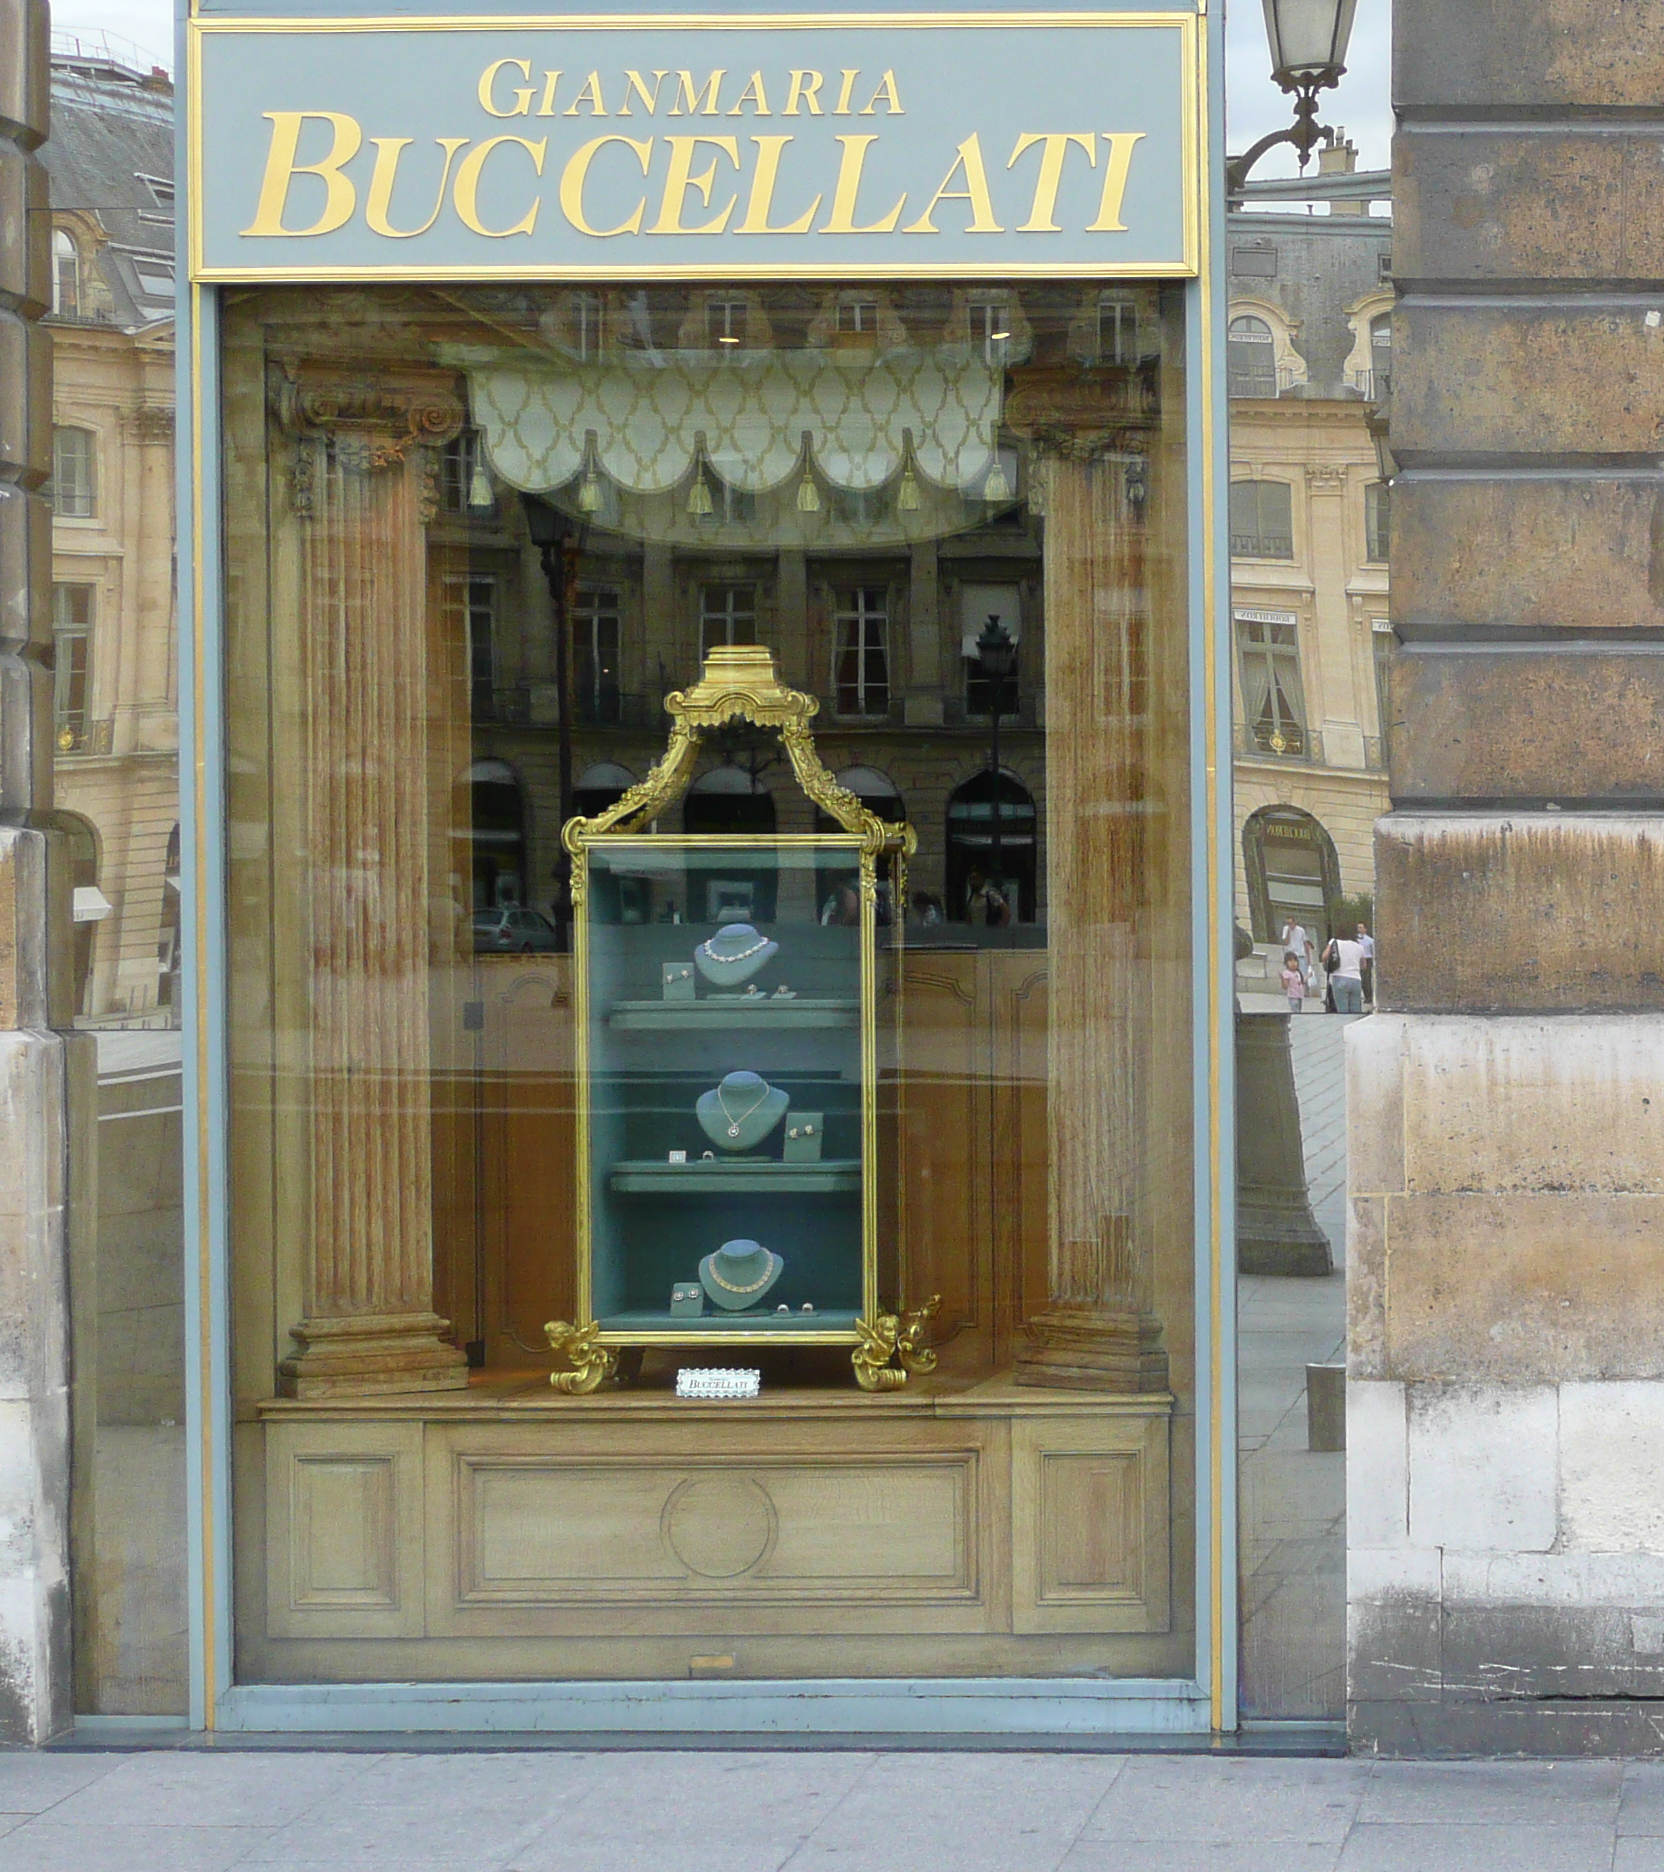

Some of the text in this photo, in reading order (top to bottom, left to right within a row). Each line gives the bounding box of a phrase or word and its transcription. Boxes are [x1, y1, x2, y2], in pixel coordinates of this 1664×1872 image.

[477, 57, 905, 118] GIANMARIA
[238, 110, 1147, 239] BUCCELLATI
[689, 1379, 748, 1389] BUCCELLATI
